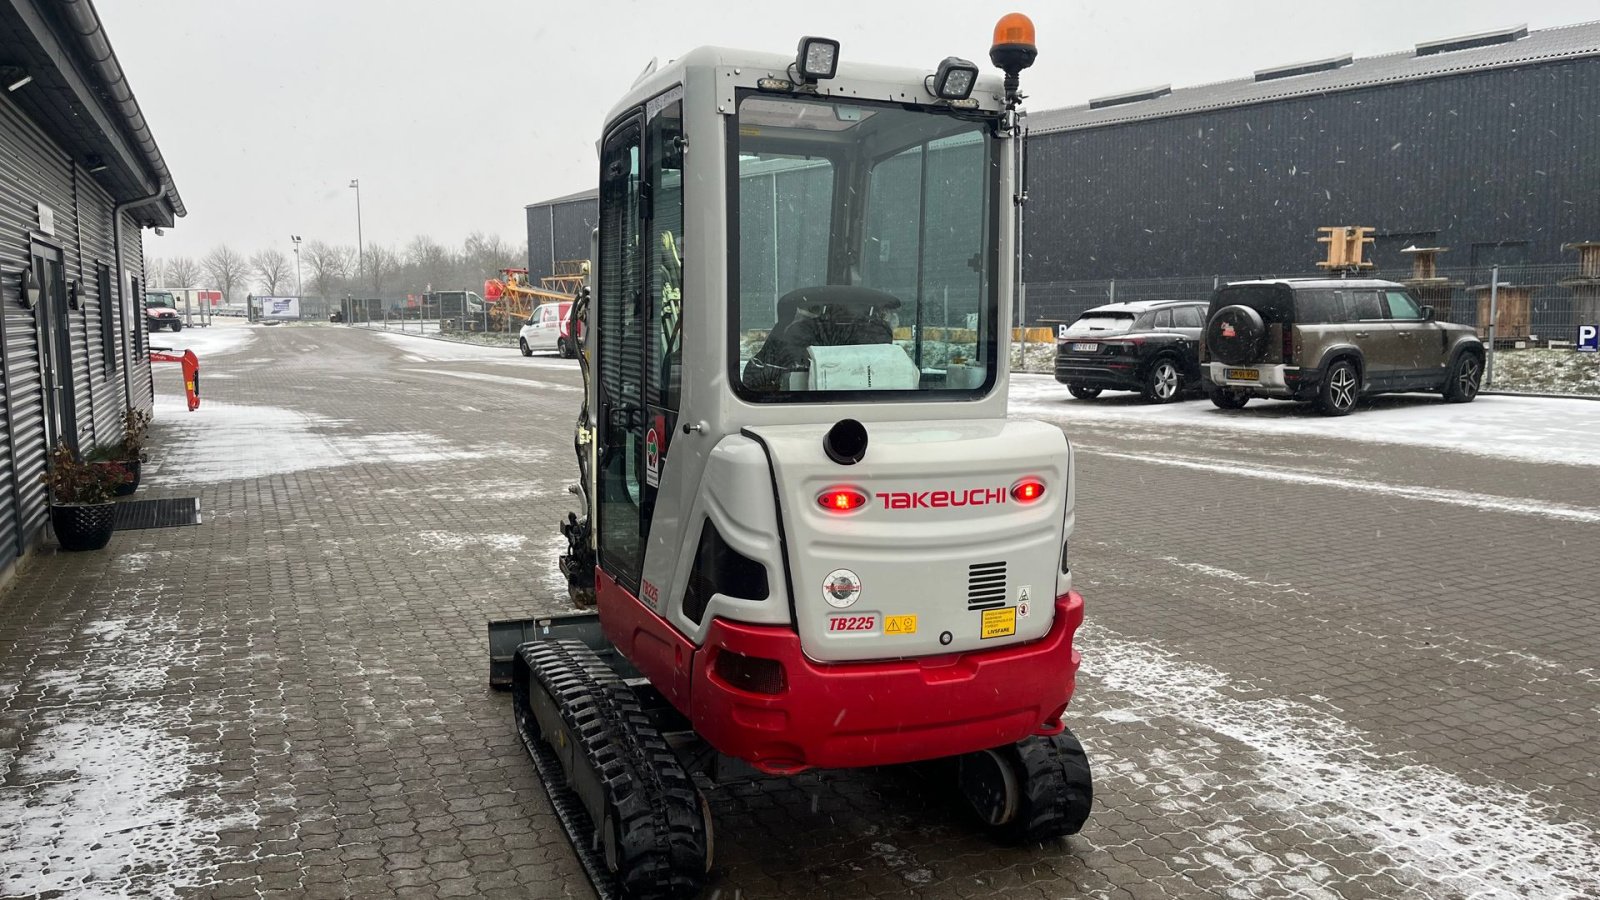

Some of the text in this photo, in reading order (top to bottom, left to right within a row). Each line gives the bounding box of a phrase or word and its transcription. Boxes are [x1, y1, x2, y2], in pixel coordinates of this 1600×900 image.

[1580, 326, 1596, 345] P
[876, 487, 1006, 509] TAKEUCHI
[830, 617, 874, 630] TB225
